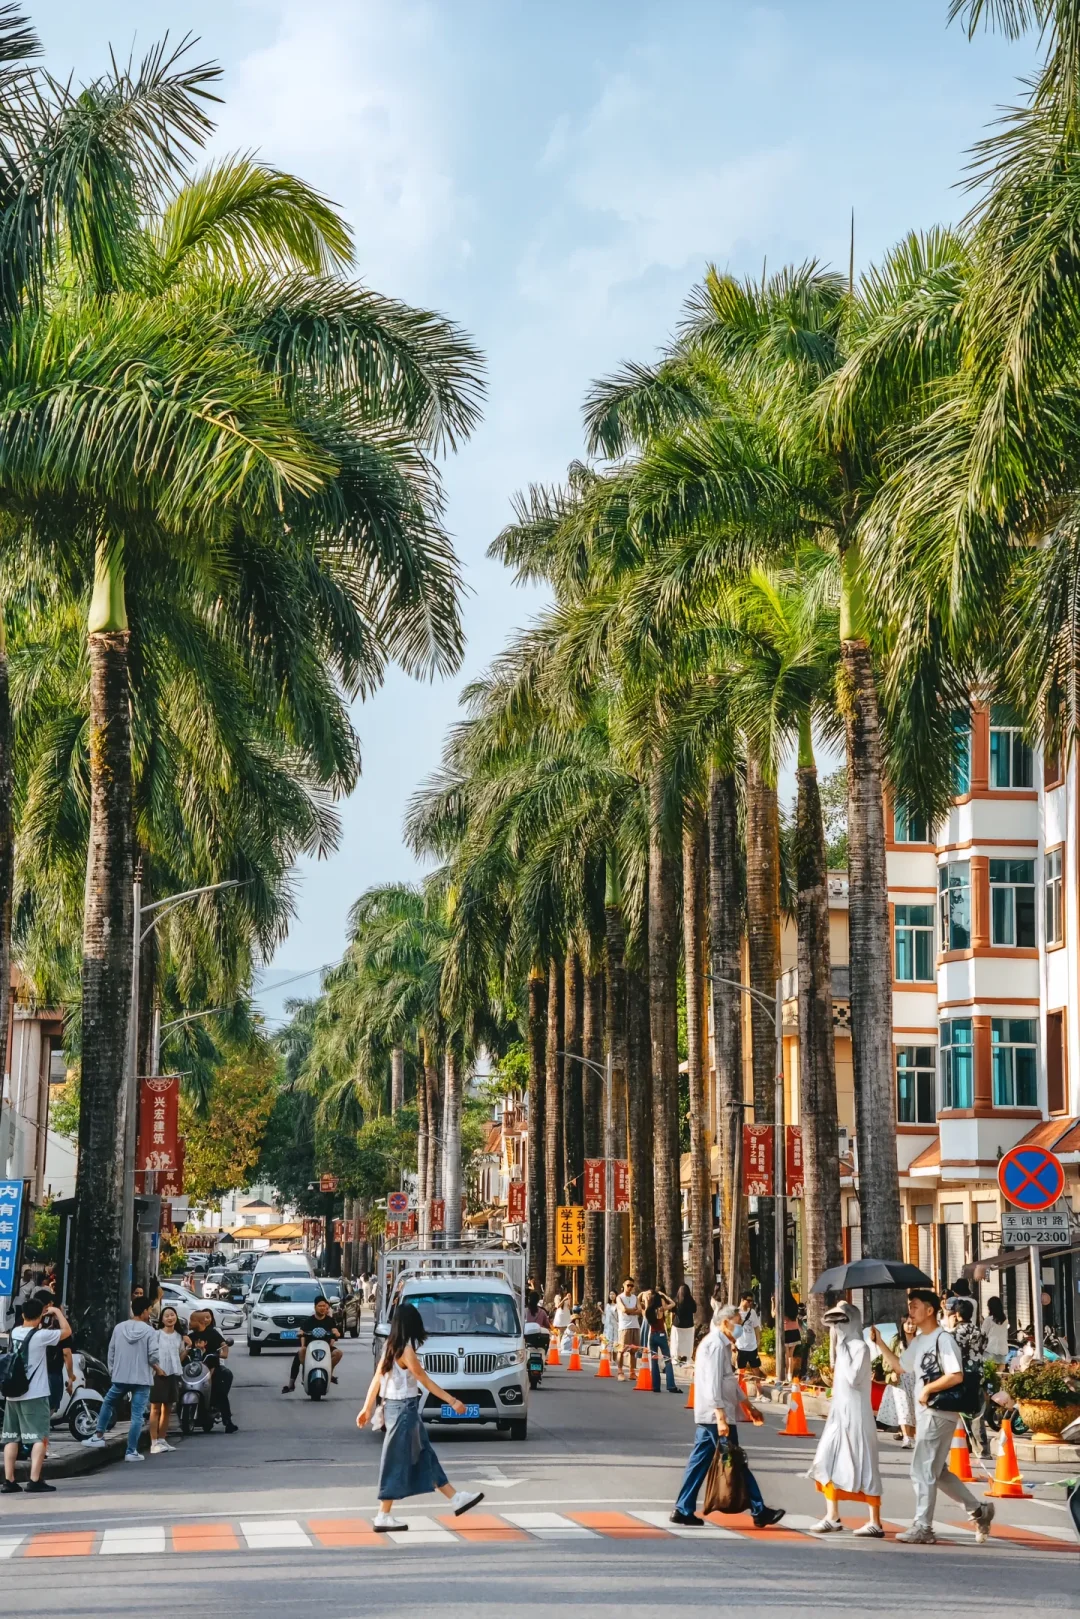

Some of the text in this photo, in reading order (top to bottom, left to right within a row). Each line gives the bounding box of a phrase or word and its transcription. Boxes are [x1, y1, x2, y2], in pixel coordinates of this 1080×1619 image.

[153, 1096, 166, 1145] 兴宏建筑
[560, 1209, 573, 1256] 学生出入
[1006, 1216, 1064, 1226] 至阔时路
[1006, 1231, 1067, 1242] 7:00-23:00
